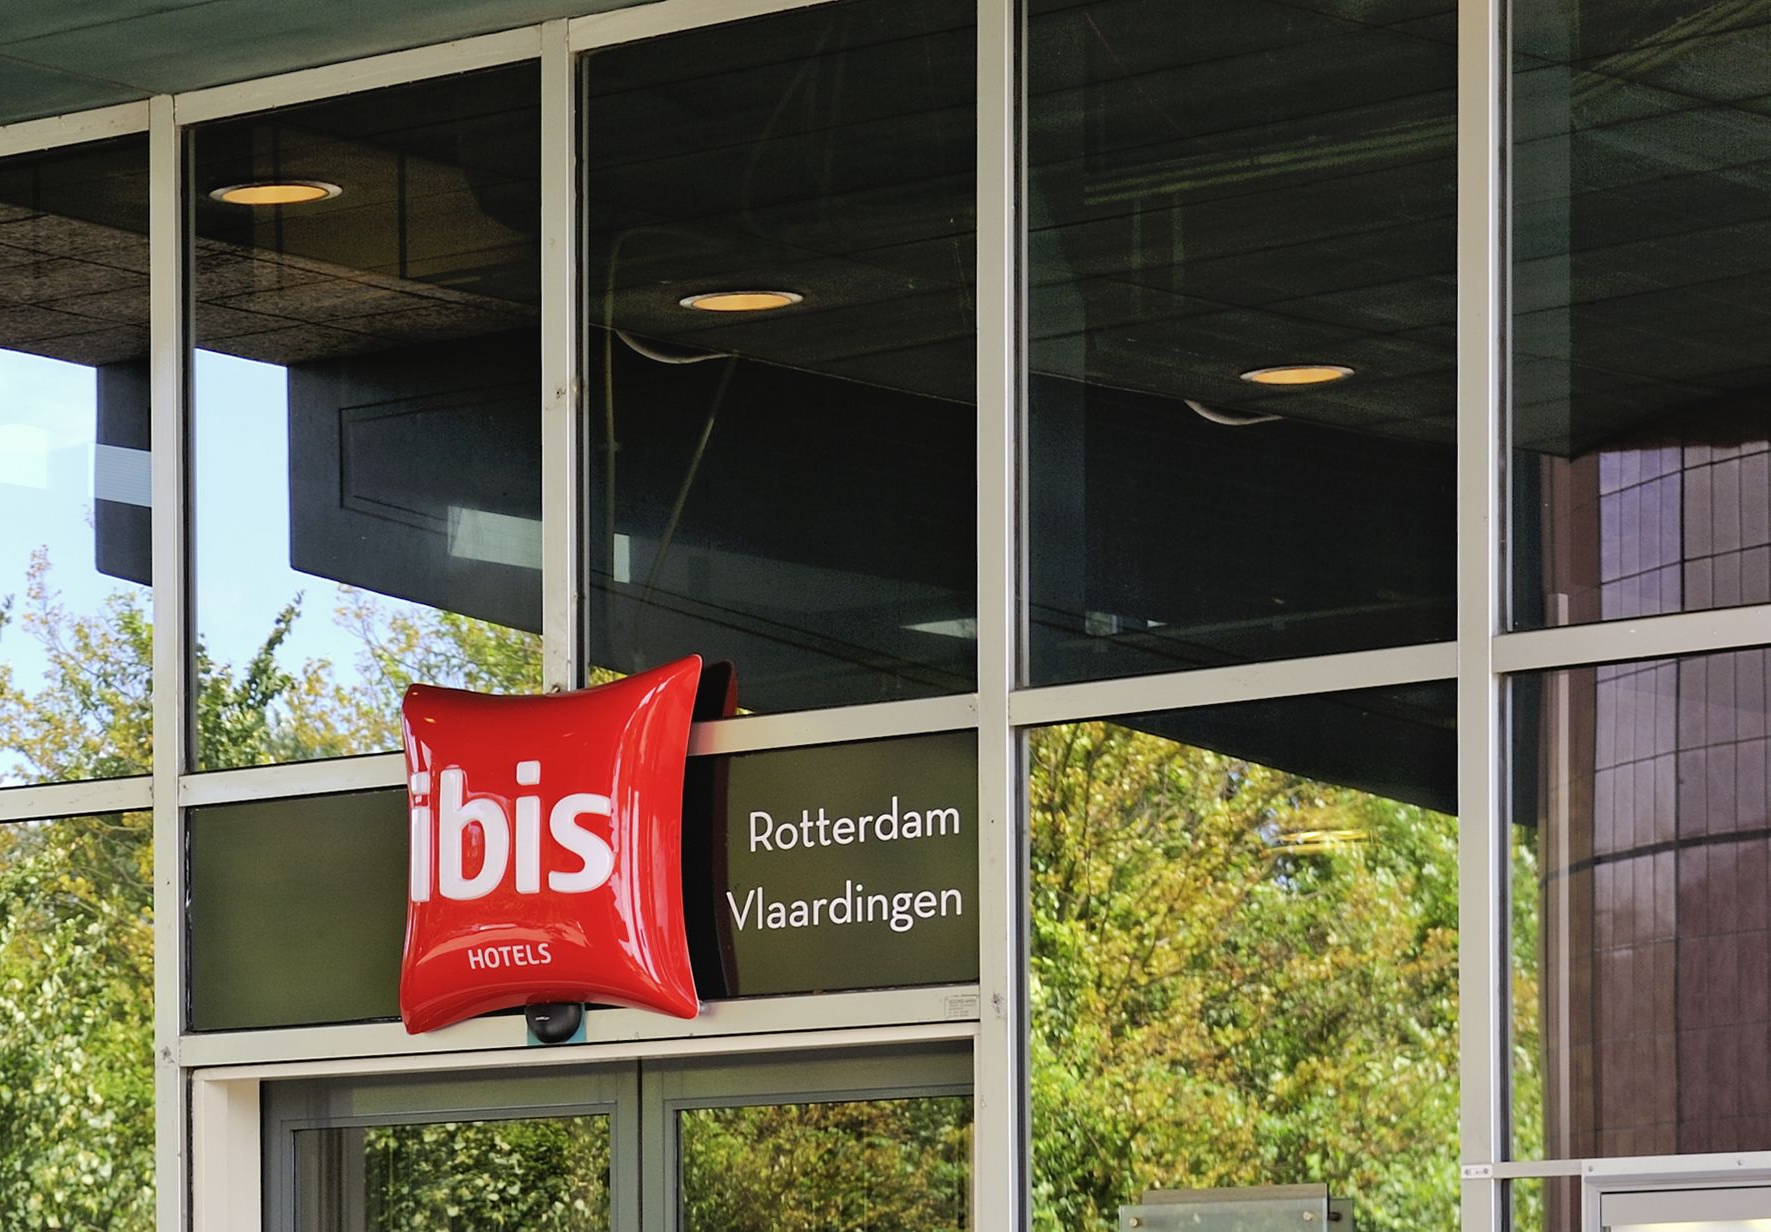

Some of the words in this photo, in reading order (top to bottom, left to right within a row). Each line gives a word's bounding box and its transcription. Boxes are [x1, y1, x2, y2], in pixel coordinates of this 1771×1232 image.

[411, 760, 615, 902] ibis
[749, 795, 961, 853] Rotterdam
[725, 879, 963, 932] Vlaardingen
[467, 942, 553, 970] HOTELS
